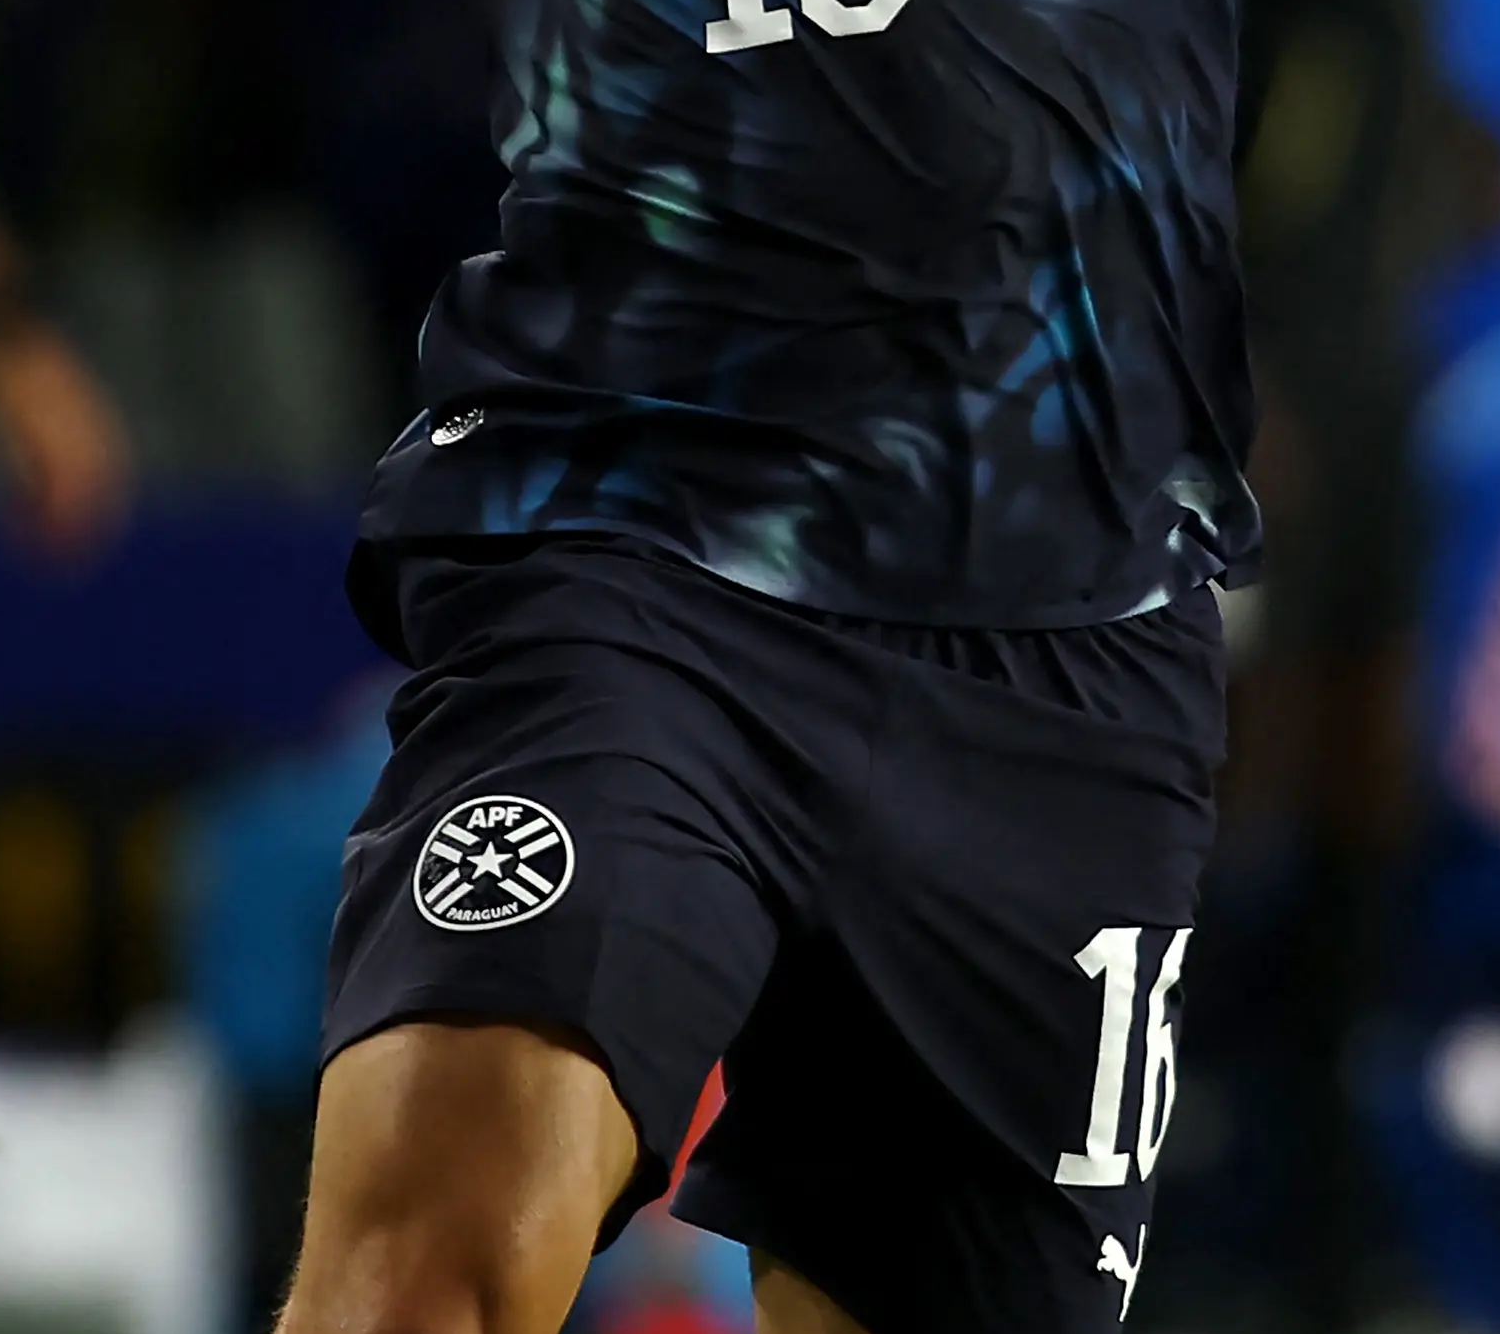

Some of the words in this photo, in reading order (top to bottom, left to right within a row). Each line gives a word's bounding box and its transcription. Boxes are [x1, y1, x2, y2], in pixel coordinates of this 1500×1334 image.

[466, 806, 524, 830] APF
[446, 902, 520, 922] PARAGUAY
[1053, 927, 1194, 1187] 16
